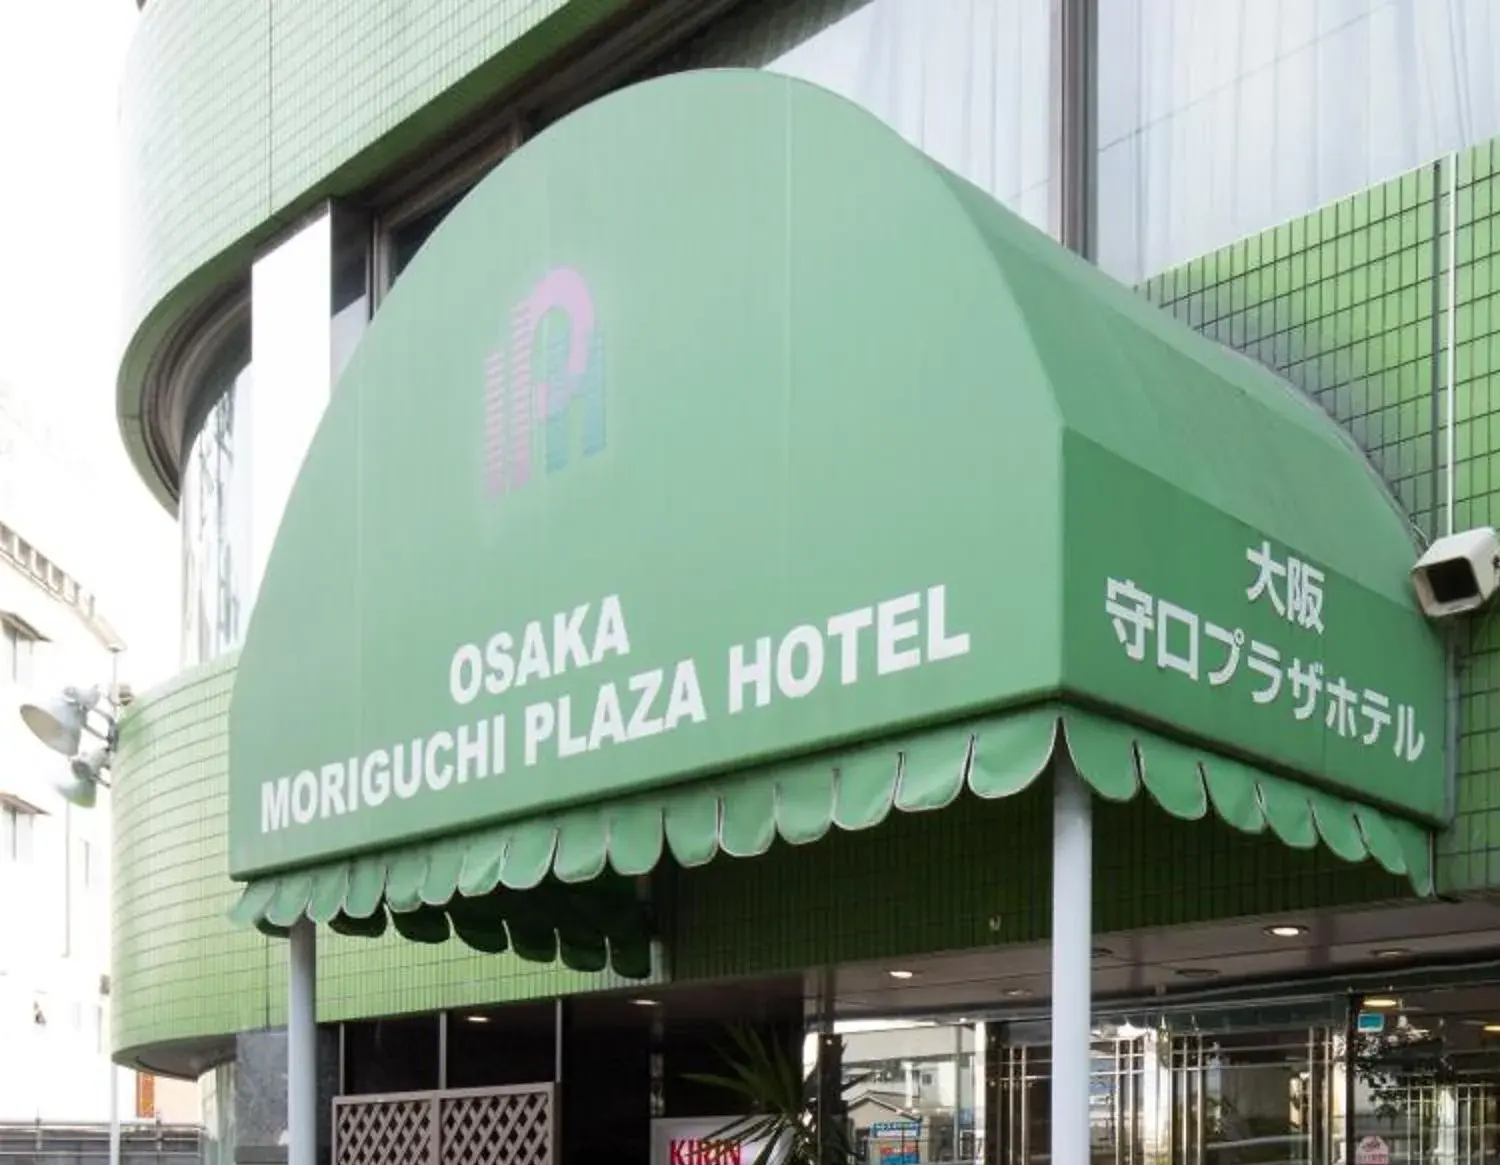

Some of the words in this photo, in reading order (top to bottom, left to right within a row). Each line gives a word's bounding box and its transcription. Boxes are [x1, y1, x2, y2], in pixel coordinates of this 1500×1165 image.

[450, 594, 630, 705] OSAKA
[1245, 541, 1326, 635] 大阪
[260, 713, 506, 833] MORIGUCHI
[524, 659, 707, 767] PLAZA
[728, 584, 971, 714] HOTEL
[1105, 577, 1425, 762] 守口プラザホテル
